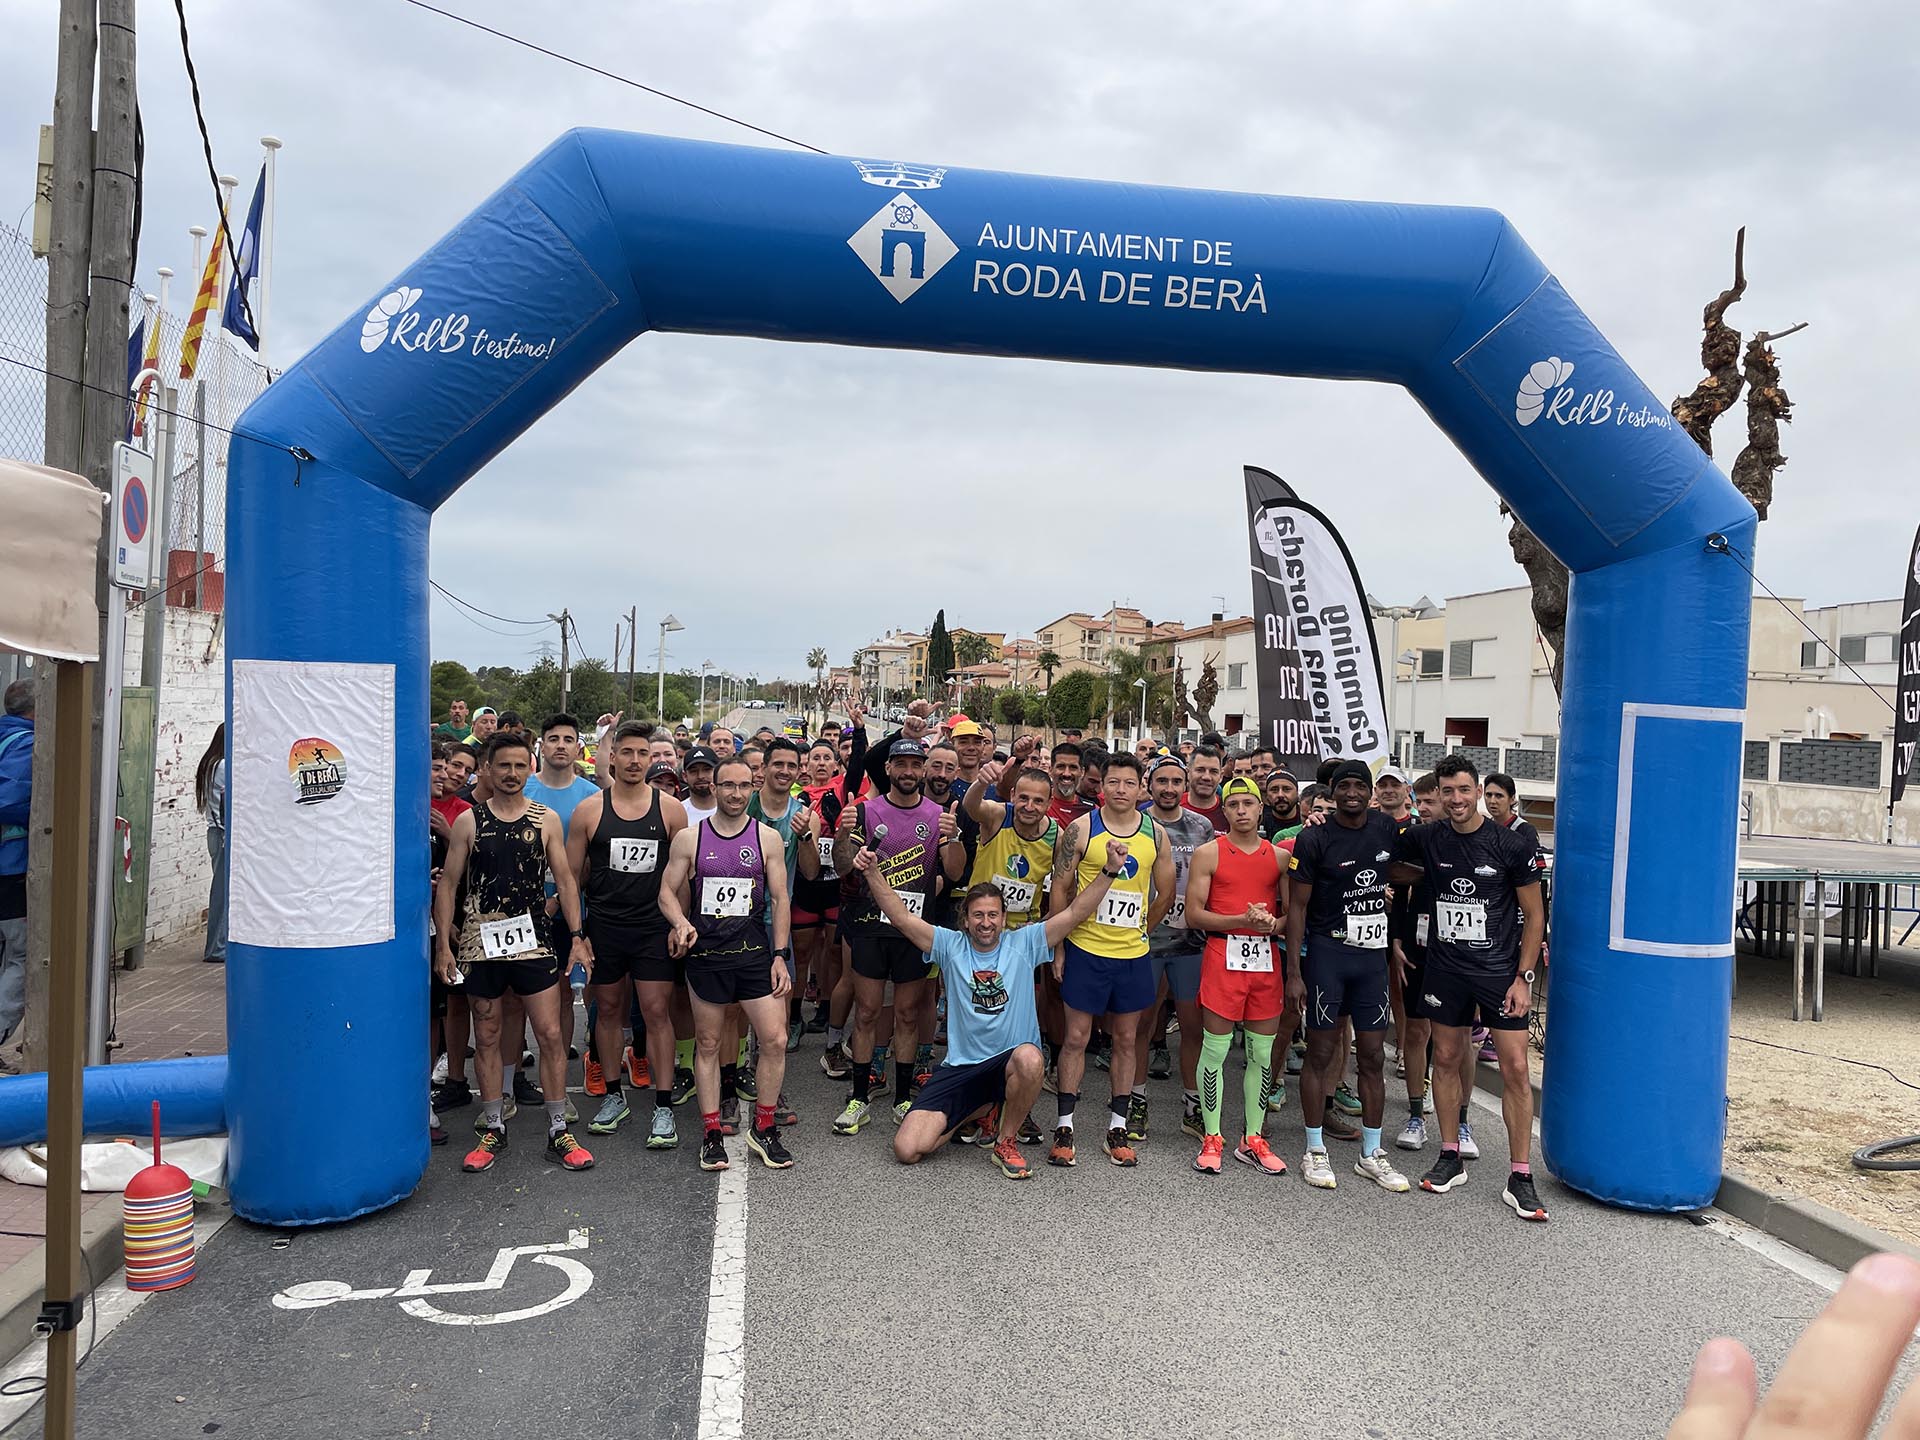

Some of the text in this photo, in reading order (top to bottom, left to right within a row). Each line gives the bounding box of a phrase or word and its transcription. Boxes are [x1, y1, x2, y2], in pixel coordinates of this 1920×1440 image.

[977, 222, 1233, 267] AJUNTAMENT DE
[972, 259, 1269, 314] RODA DE BERÀ
[391, 311, 556, 360] RdB t'estimo!
[1546, 386, 1672, 431] RdB t'estimo!
[622, 845, 650, 861] 127
[716, 886, 737, 903] 69
[1001, 883, 1026, 902] 120
[1342, 883, 1389, 899] AUTOFORUM
[1440, 893, 1490, 906] AUTOFORUM
[1108, 899, 1136, 918] 170
[1342, 898, 1385, 914] KINTO
[1446, 910, 1473, 927] 121
[493, 926, 525, 949] 161
[1356, 923, 1382, 941] 150
[1241, 942, 1261, 958] 84
